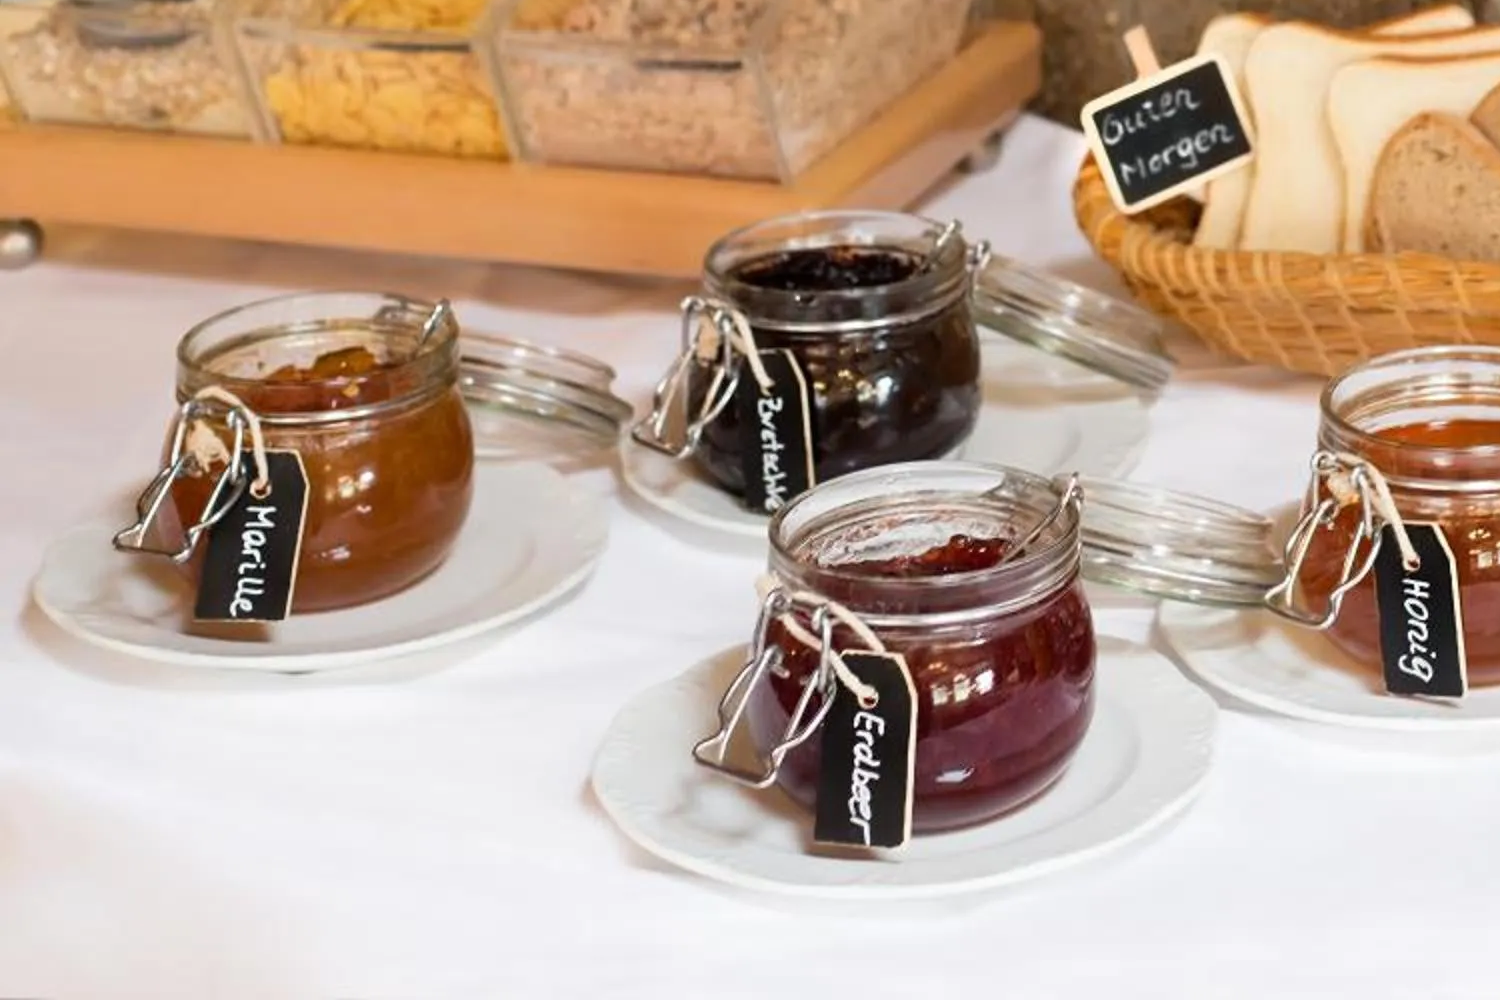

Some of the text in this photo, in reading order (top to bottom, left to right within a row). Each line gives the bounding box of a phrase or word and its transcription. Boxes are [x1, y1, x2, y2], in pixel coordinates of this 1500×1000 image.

[1119, 123, 1235, 186] Morgen
[229, 505, 277, 617] Marille
[1398, 577, 1437, 684] Honig
[848, 710, 886, 846] Erdbeer
